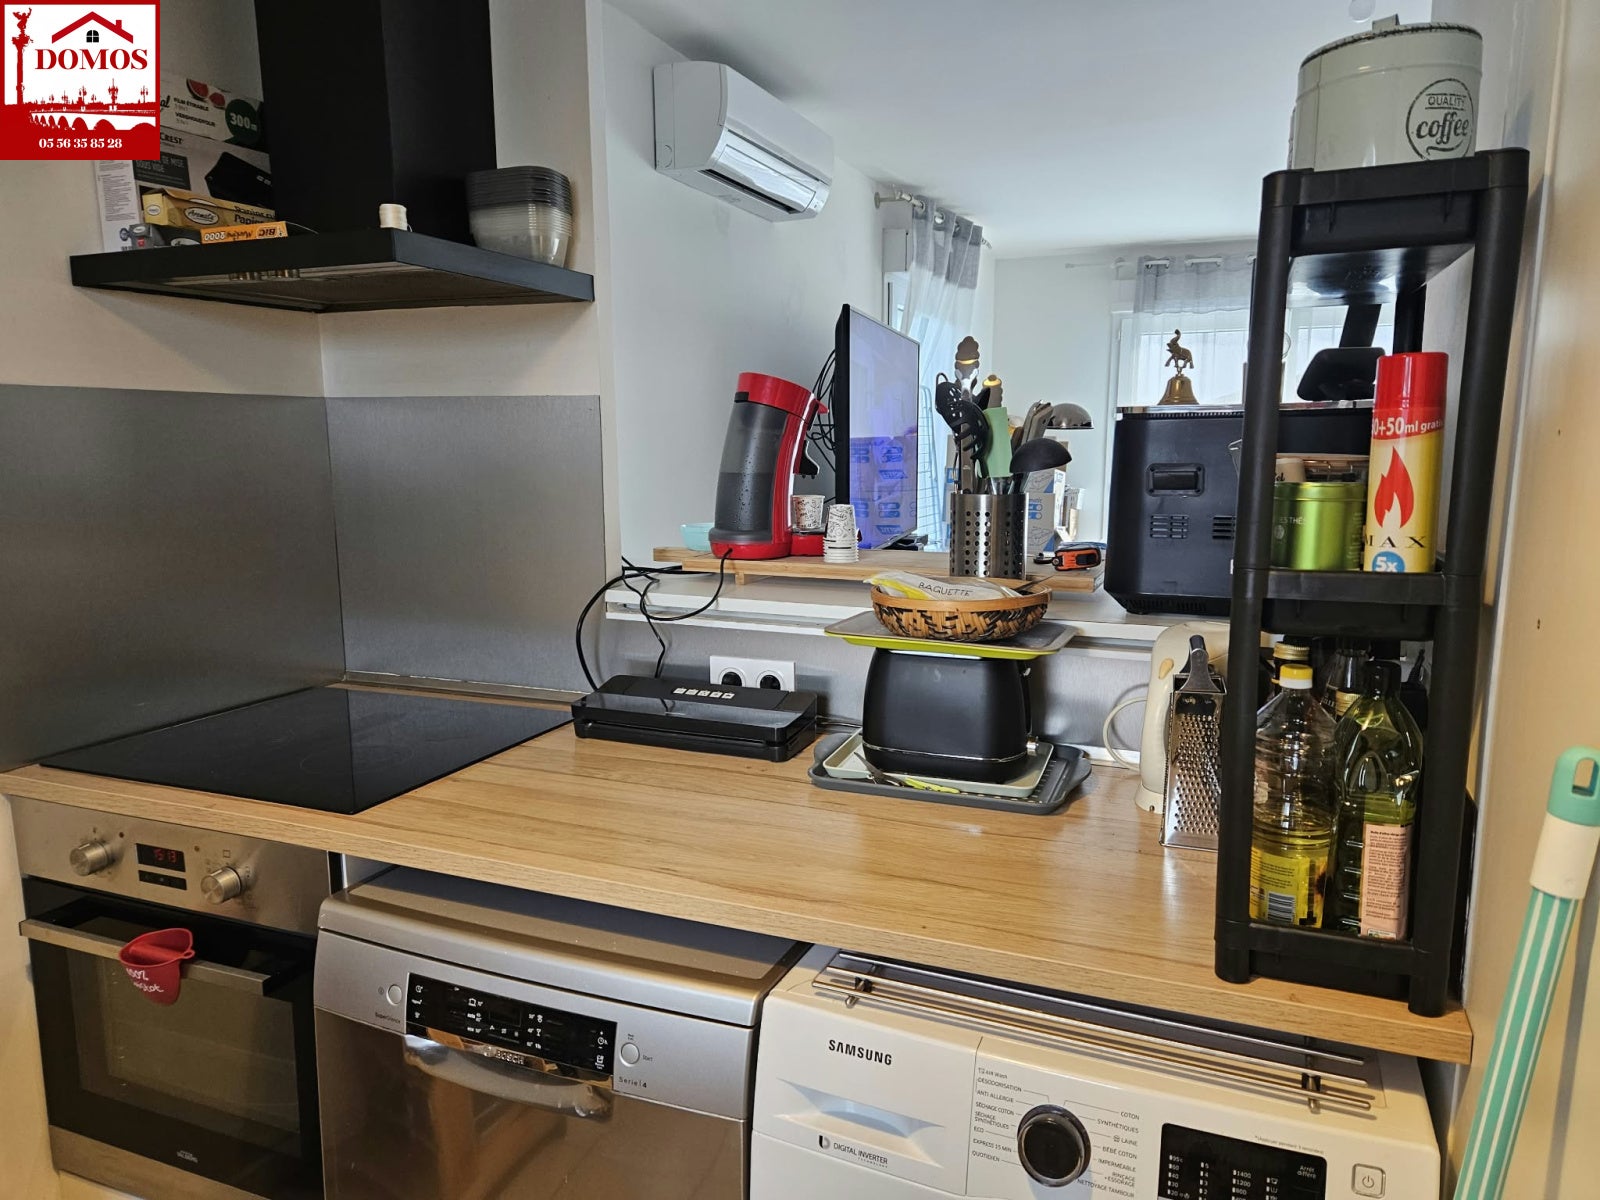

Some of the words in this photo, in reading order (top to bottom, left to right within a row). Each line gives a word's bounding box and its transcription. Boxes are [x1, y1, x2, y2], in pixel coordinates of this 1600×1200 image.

[1428, 96, 1466, 107] QUALITY
[1416, 112, 1470, 145] coffee
[204, 230, 226, 241] 2000
[258, 226, 276, 236] BIC
[1376, 556, 1399, 572] 5x
[918, 581, 973, 597] BAGUETTE
[495, 1050, 524, 1065] BOSCH
[828, 1039, 892, 1066] SAMSUNG
[998, 1108, 1014, 1116] COTON
[1120, 1111, 1140, 1120] COTON
[1097, 1118, 1140, 1134] SYNTHÉTIQUES
[972, 1138, 994, 1148] EXPRESS
[1120, 1137, 1138, 1147] LAINE
[834, 1142, 856, 1156] DIGITAL
[858, 1150, 888, 1164] INVERTER
[972, 1150, 1000, 1162] QUOTIDIEN
[1102, 1146, 1117, 1155] BÉBÉ
[1118, 1150, 1138, 1160] COTON
[1236, 1170, 1252, 1179] 1400
[1078, 1178, 1108, 1190] NETTOYAGE
[1108, 1187, 1134, 1198] TAMBOUR
[1236, 1178, 1251, 1188] 1200
